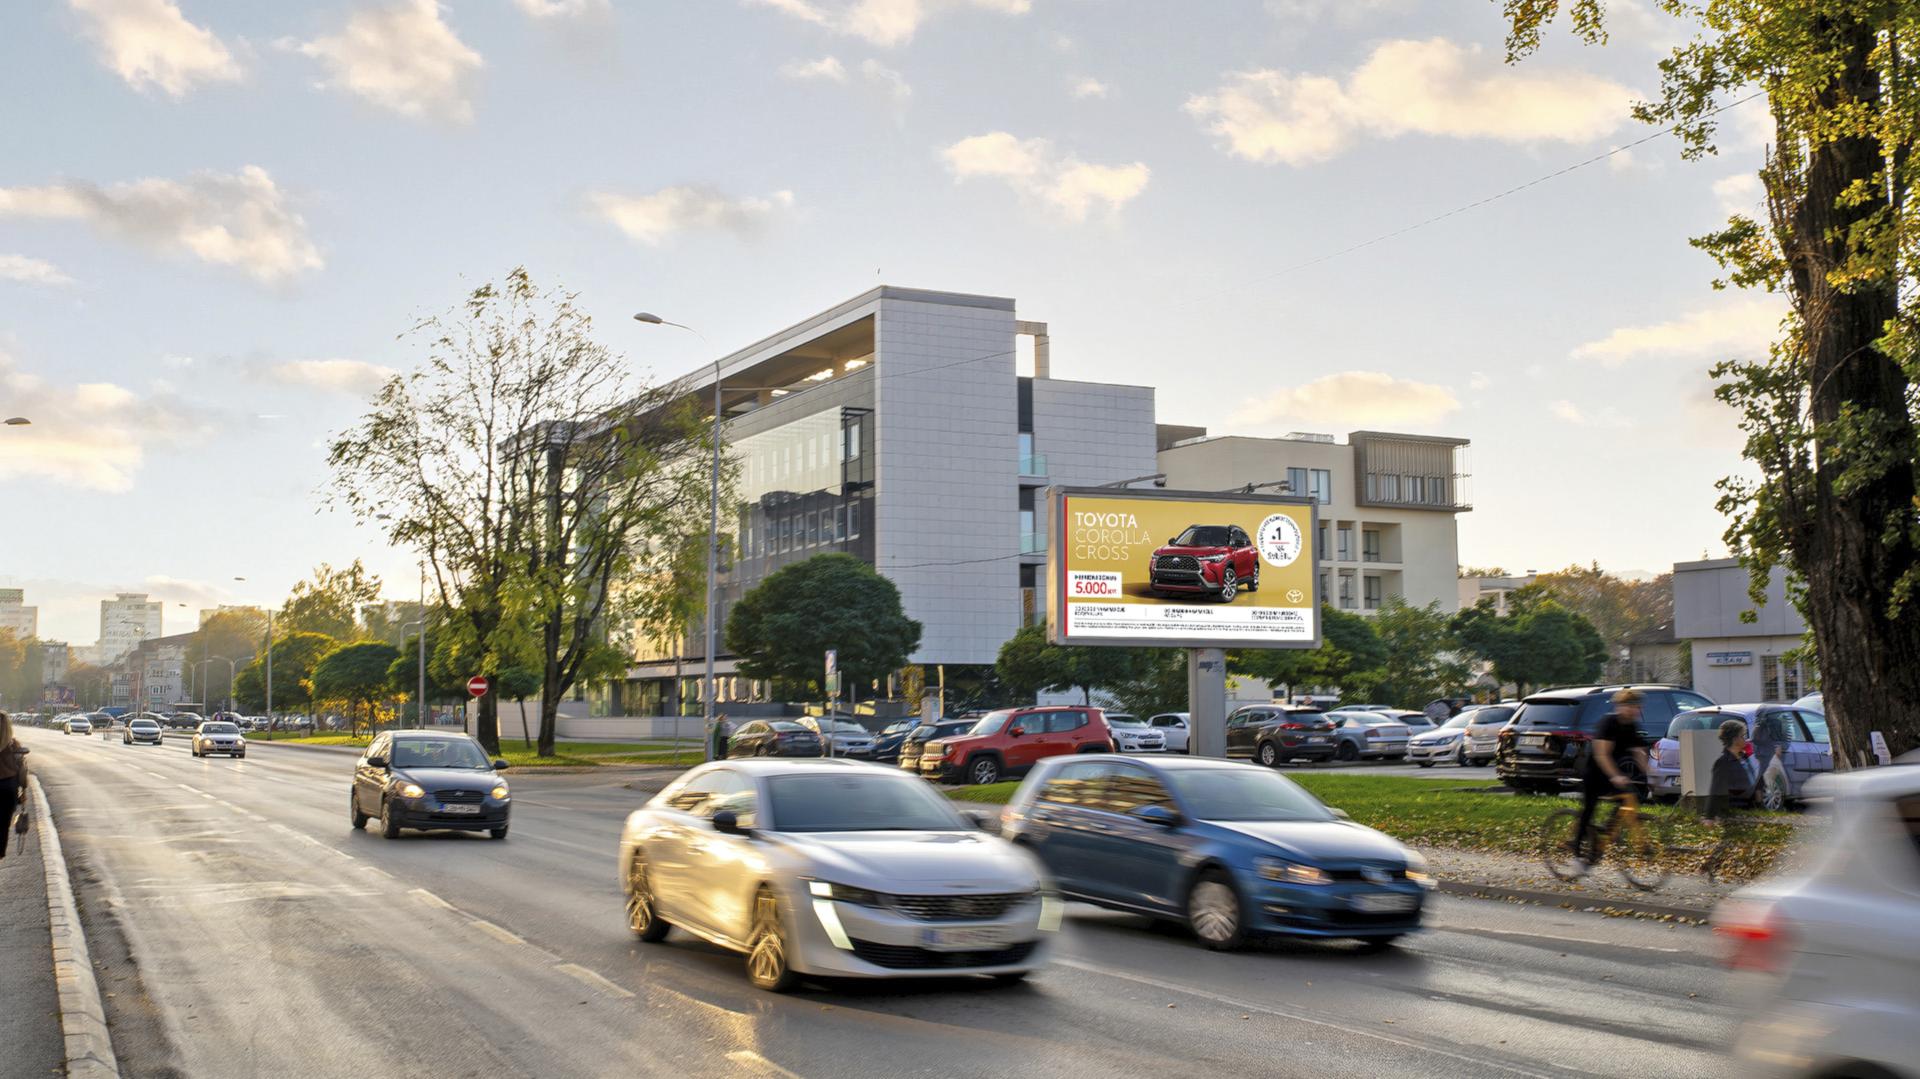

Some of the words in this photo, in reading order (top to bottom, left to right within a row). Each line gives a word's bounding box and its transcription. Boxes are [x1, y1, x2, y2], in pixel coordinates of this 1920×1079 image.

[1075, 512, 1138, 528] TOYOTA
[1075, 528, 1152, 545] COROLLA
[1075, 544, 1129, 561] CROSS
[1075, 581, 1107, 595] 5.000
